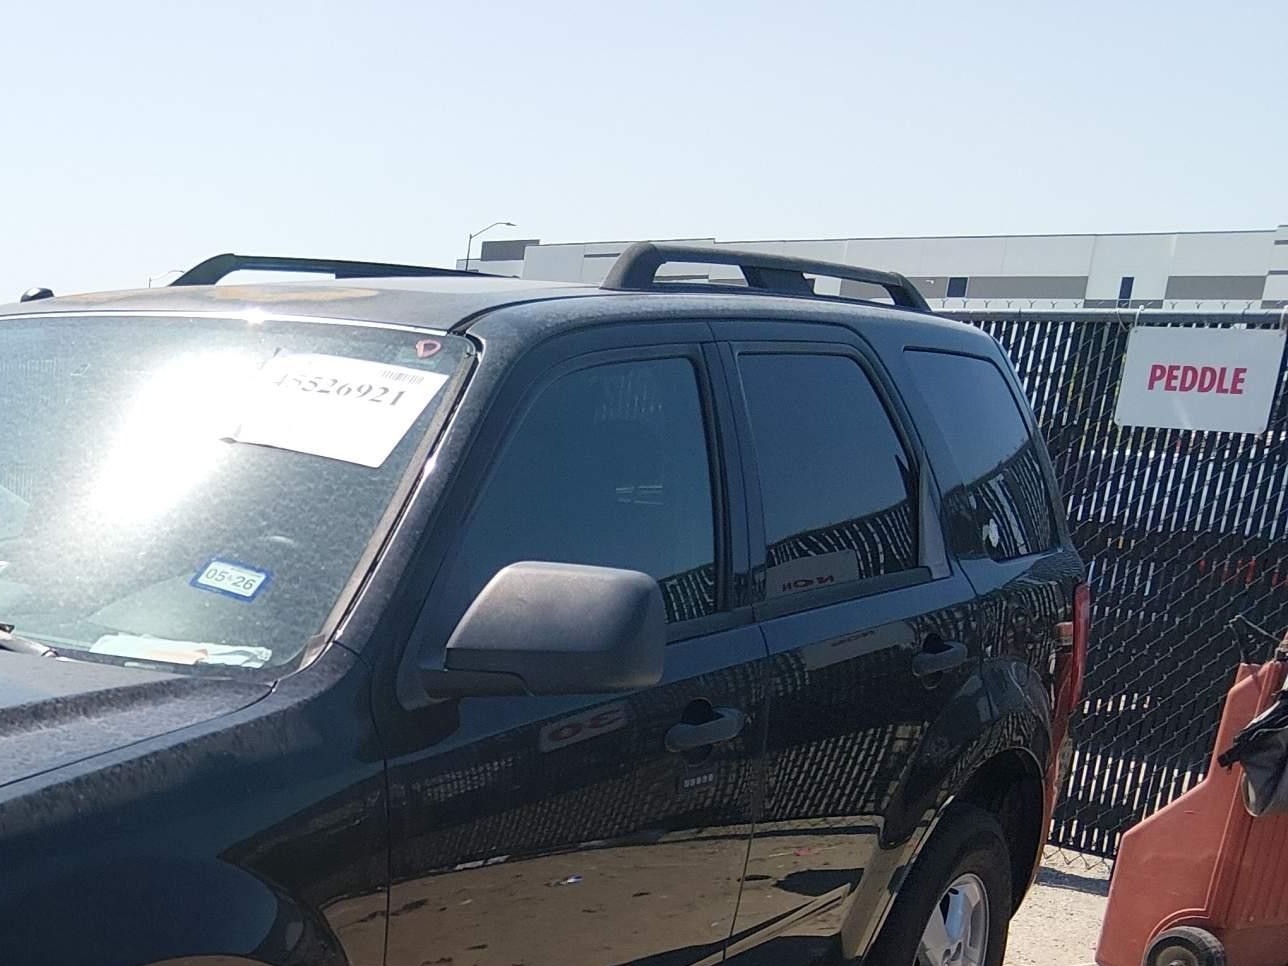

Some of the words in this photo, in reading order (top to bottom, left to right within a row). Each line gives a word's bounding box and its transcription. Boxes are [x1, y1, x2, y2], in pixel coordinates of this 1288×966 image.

[1148, 364, 1247, 395] PEDDLE
[206, 568, 229, 582] 05
[232, 575, 257, 591] 26
